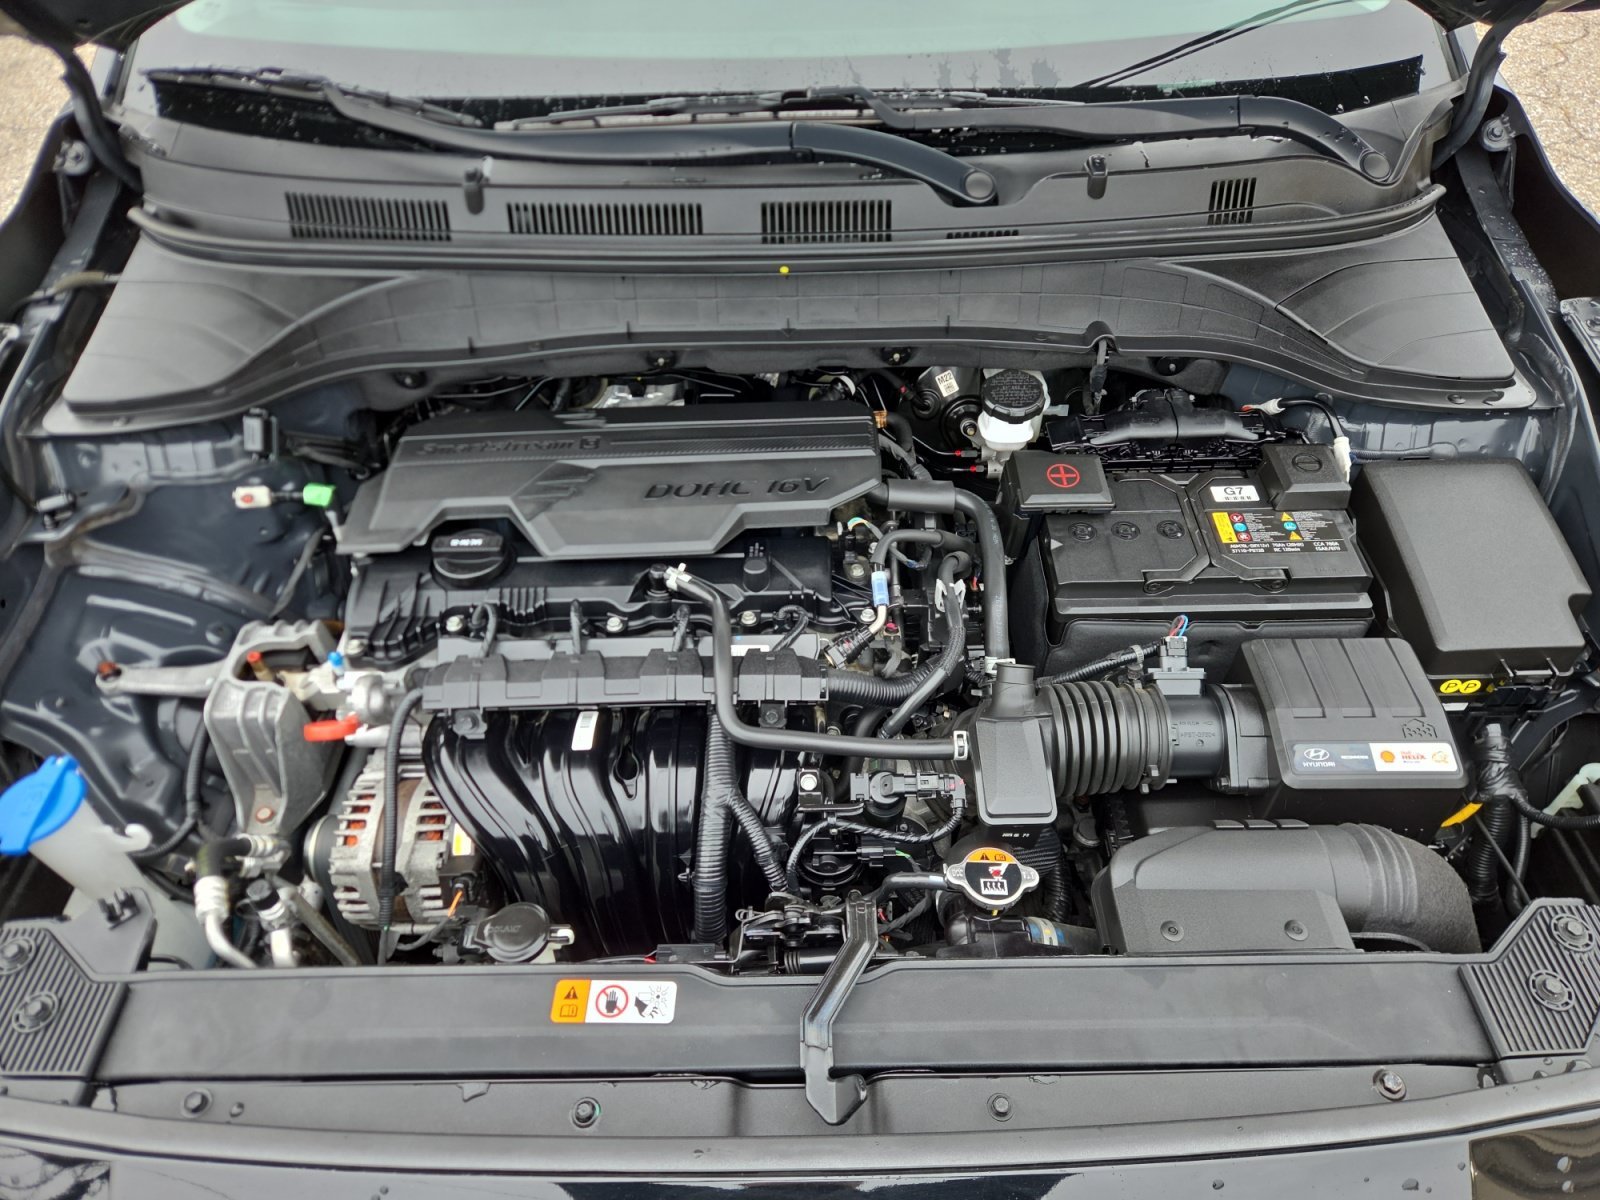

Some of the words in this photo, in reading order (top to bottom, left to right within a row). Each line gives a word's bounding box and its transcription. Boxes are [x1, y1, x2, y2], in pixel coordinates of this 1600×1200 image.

[936, 371, 953, 385] M22
[644, 480, 756, 499] DOHC
[766, 476, 830, 495] 16V
[1223, 486, 1243, 496] G7
[1445, 682, 1458, 691] P
[1464, 682, 1477, 691] P
